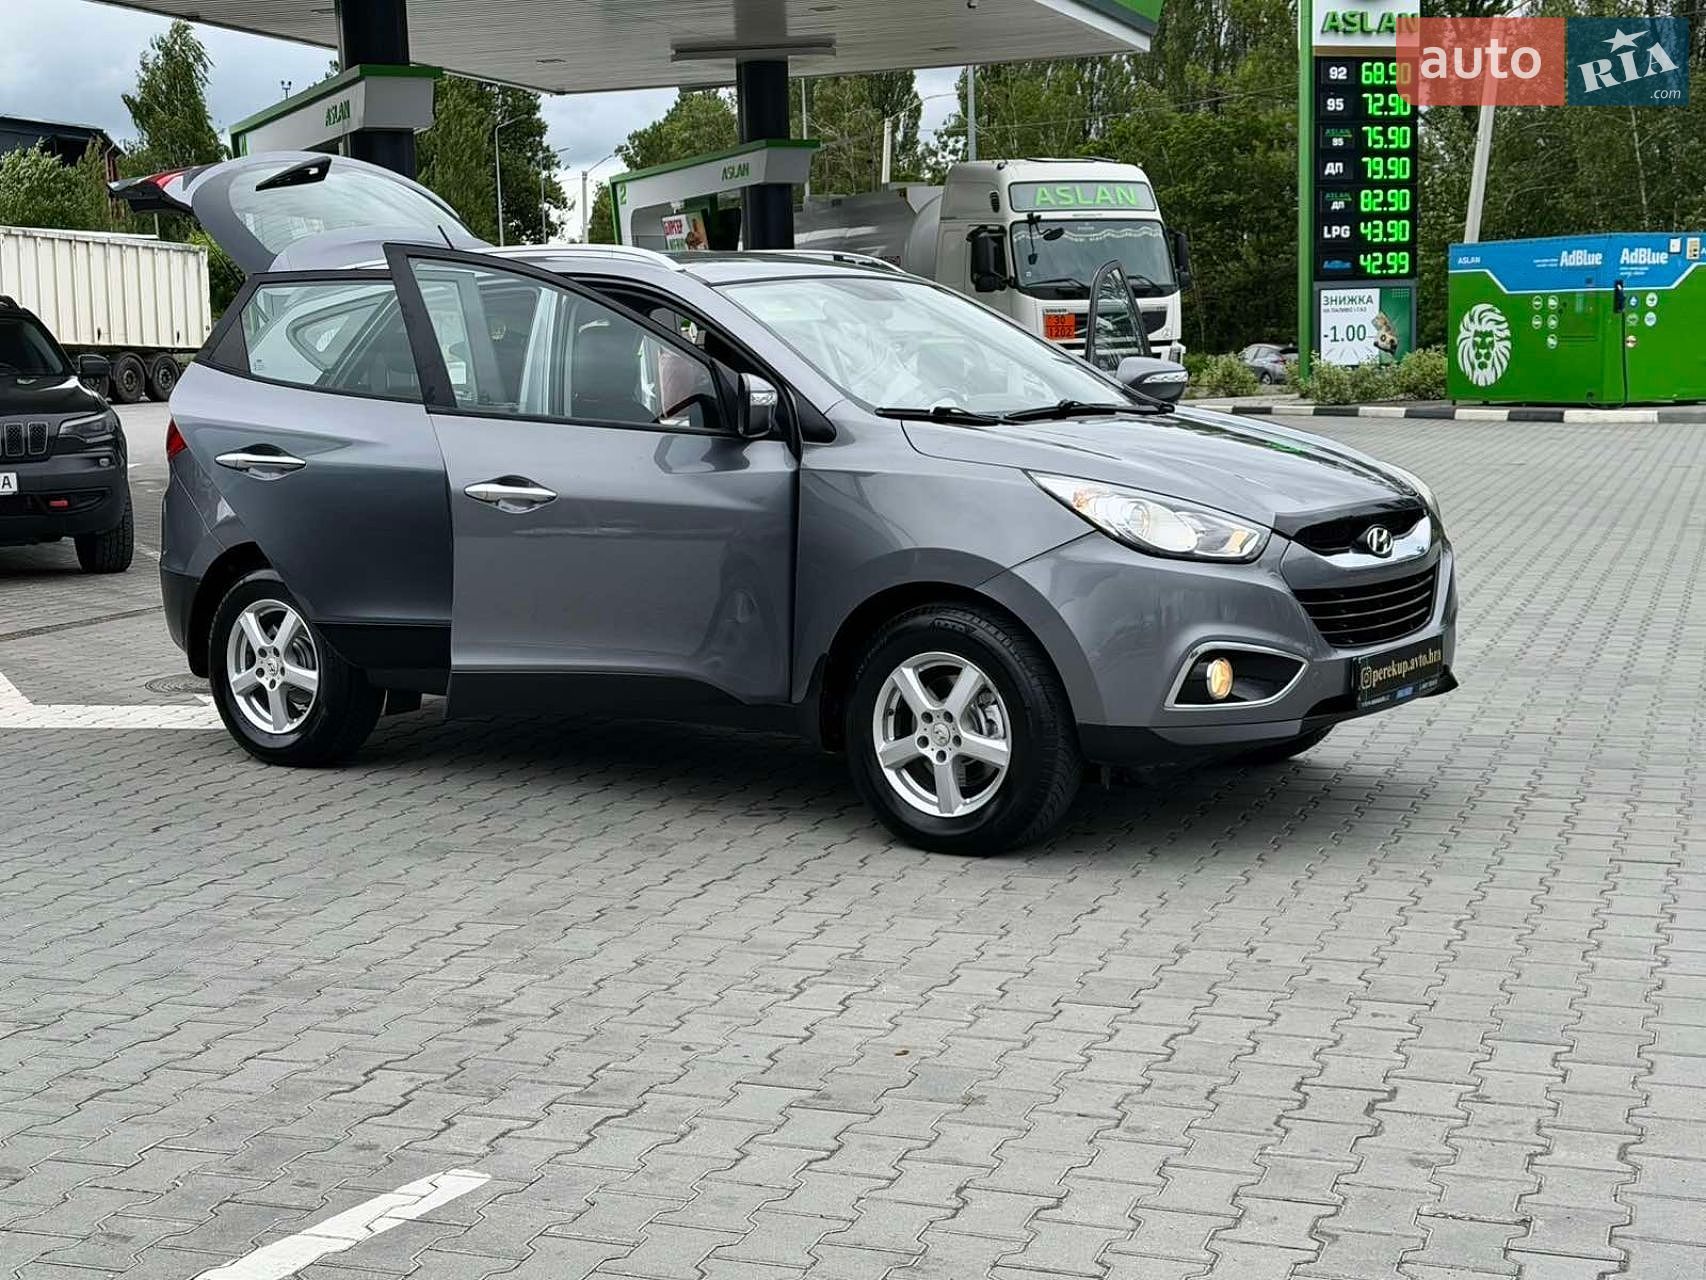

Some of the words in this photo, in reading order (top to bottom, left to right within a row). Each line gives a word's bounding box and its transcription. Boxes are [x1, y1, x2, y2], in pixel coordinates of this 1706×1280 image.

[1322, 11, 1419, 34] ASLAN
[1329, 66, 1348, 80] 92
[1361, 62, 1412, 85] 68.90
[325, 100, 350, 127] ASLAN
[1326, 98, 1345, 112] 95
[1361, 93, 1411, 116] 72.90
[1361, 126, 1411, 149] 75.90
[722, 162, 750, 182] ASLAN
[1324, 162, 1344, 175] ДП
[1361, 157, 1411, 180] 79.90
[619, 184, 627, 205] 2
[1035, 185, 1138, 206] ASLAN
[1360, 189, 1411, 212] 82.90
[1323, 225, 1351, 239] LPG
[1360, 220, 1410, 243] 43.90
[1359, 252, 1409, 275] 42.99
[1560, 250, 1603, 267] AdBlue
[1619, 247, 1669, 265] AdBlue
[1323, 294, 1374, 306] ЗНИЖКА
[1053, 315, 1066, 324] 30
[1049, 327, 1072, 338] 1202
[1323, 324, 1367, 342] -1.00
